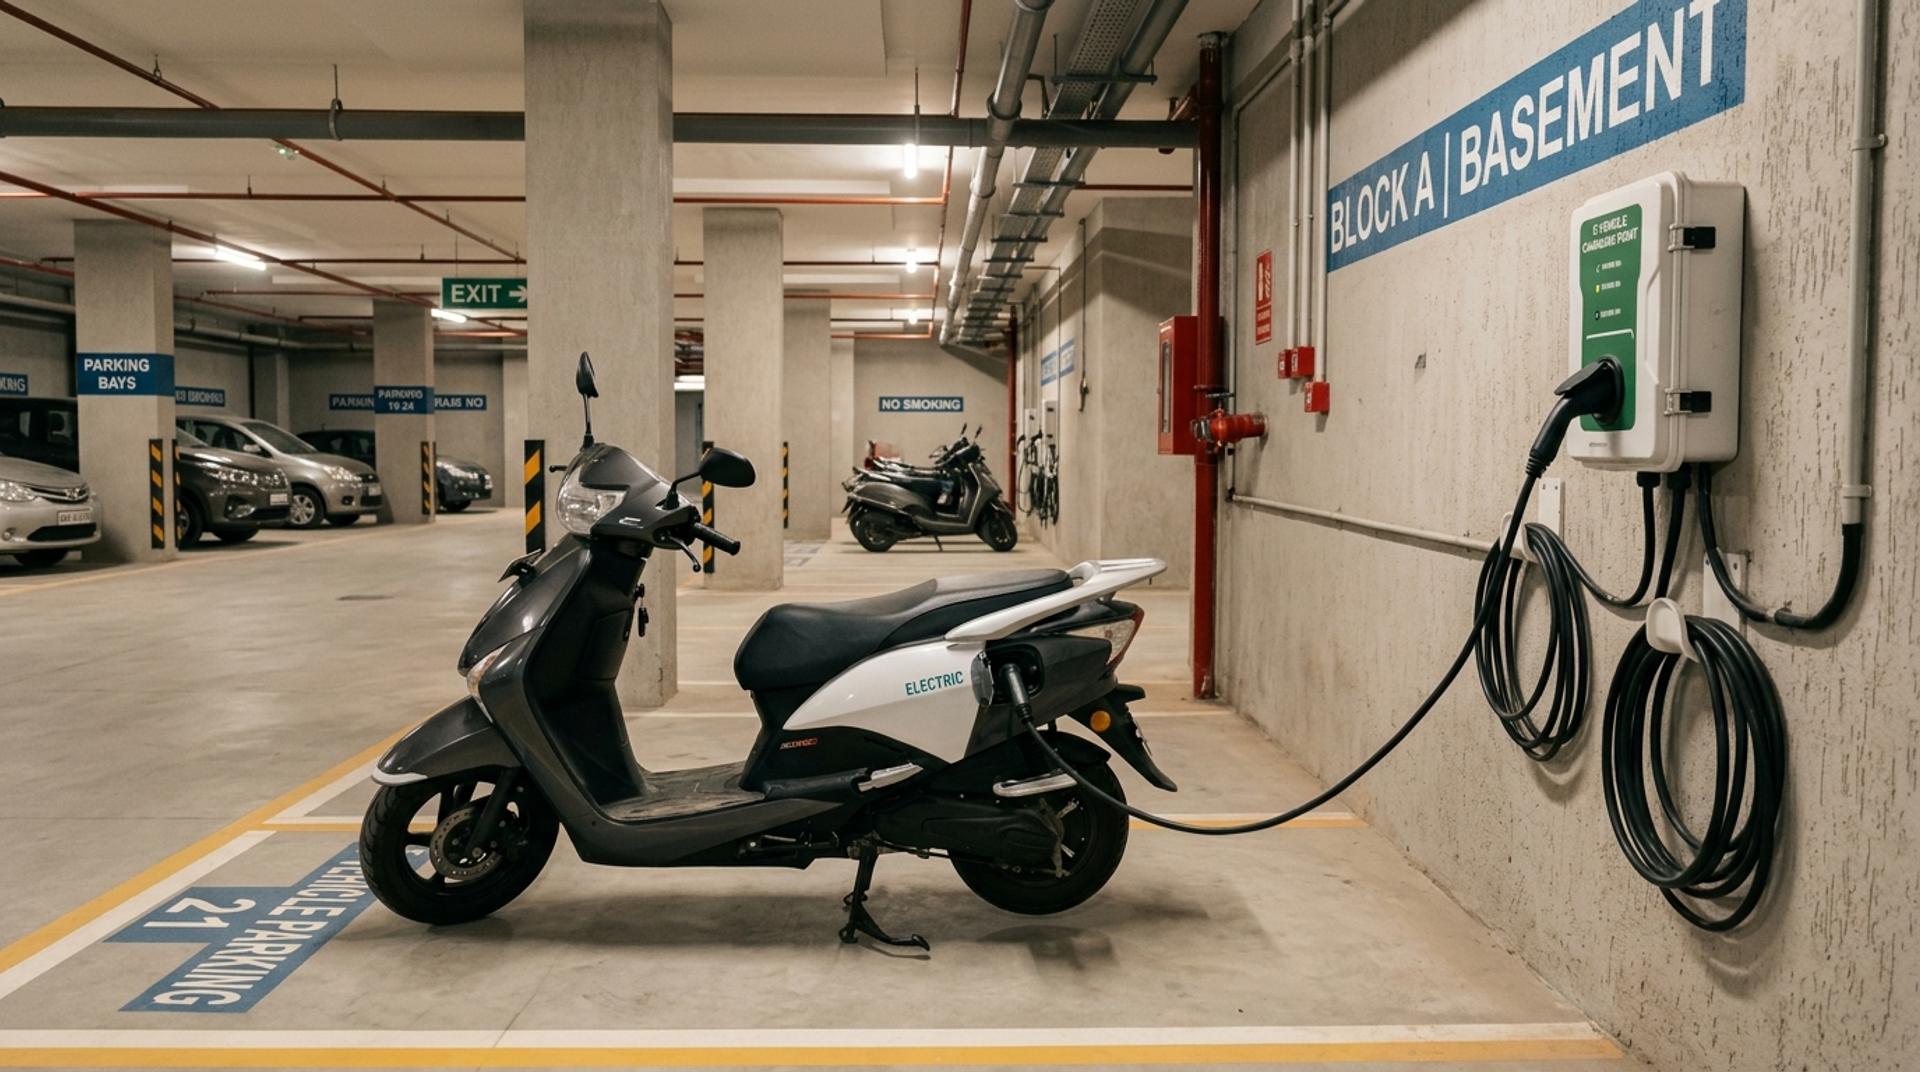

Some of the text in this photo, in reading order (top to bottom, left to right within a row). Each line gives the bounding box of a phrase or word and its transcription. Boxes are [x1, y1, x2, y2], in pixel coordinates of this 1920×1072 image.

[1330, 162, 1409, 255] BLOCK
[1413, 150, 1435, 217] A
[1459, 0, 1720, 197] BASEMENT
[451, 284, 502, 303] EXIT
[84, 358, 150, 373] PARKING
[98, 376, 137, 390] BAYS
[882, 399, 961, 410] NO SMOKING
[905, 671, 964, 696] ELECTRIC
[143, 897, 257, 929] 21
[153, 919, 330, 1006] PARKING
